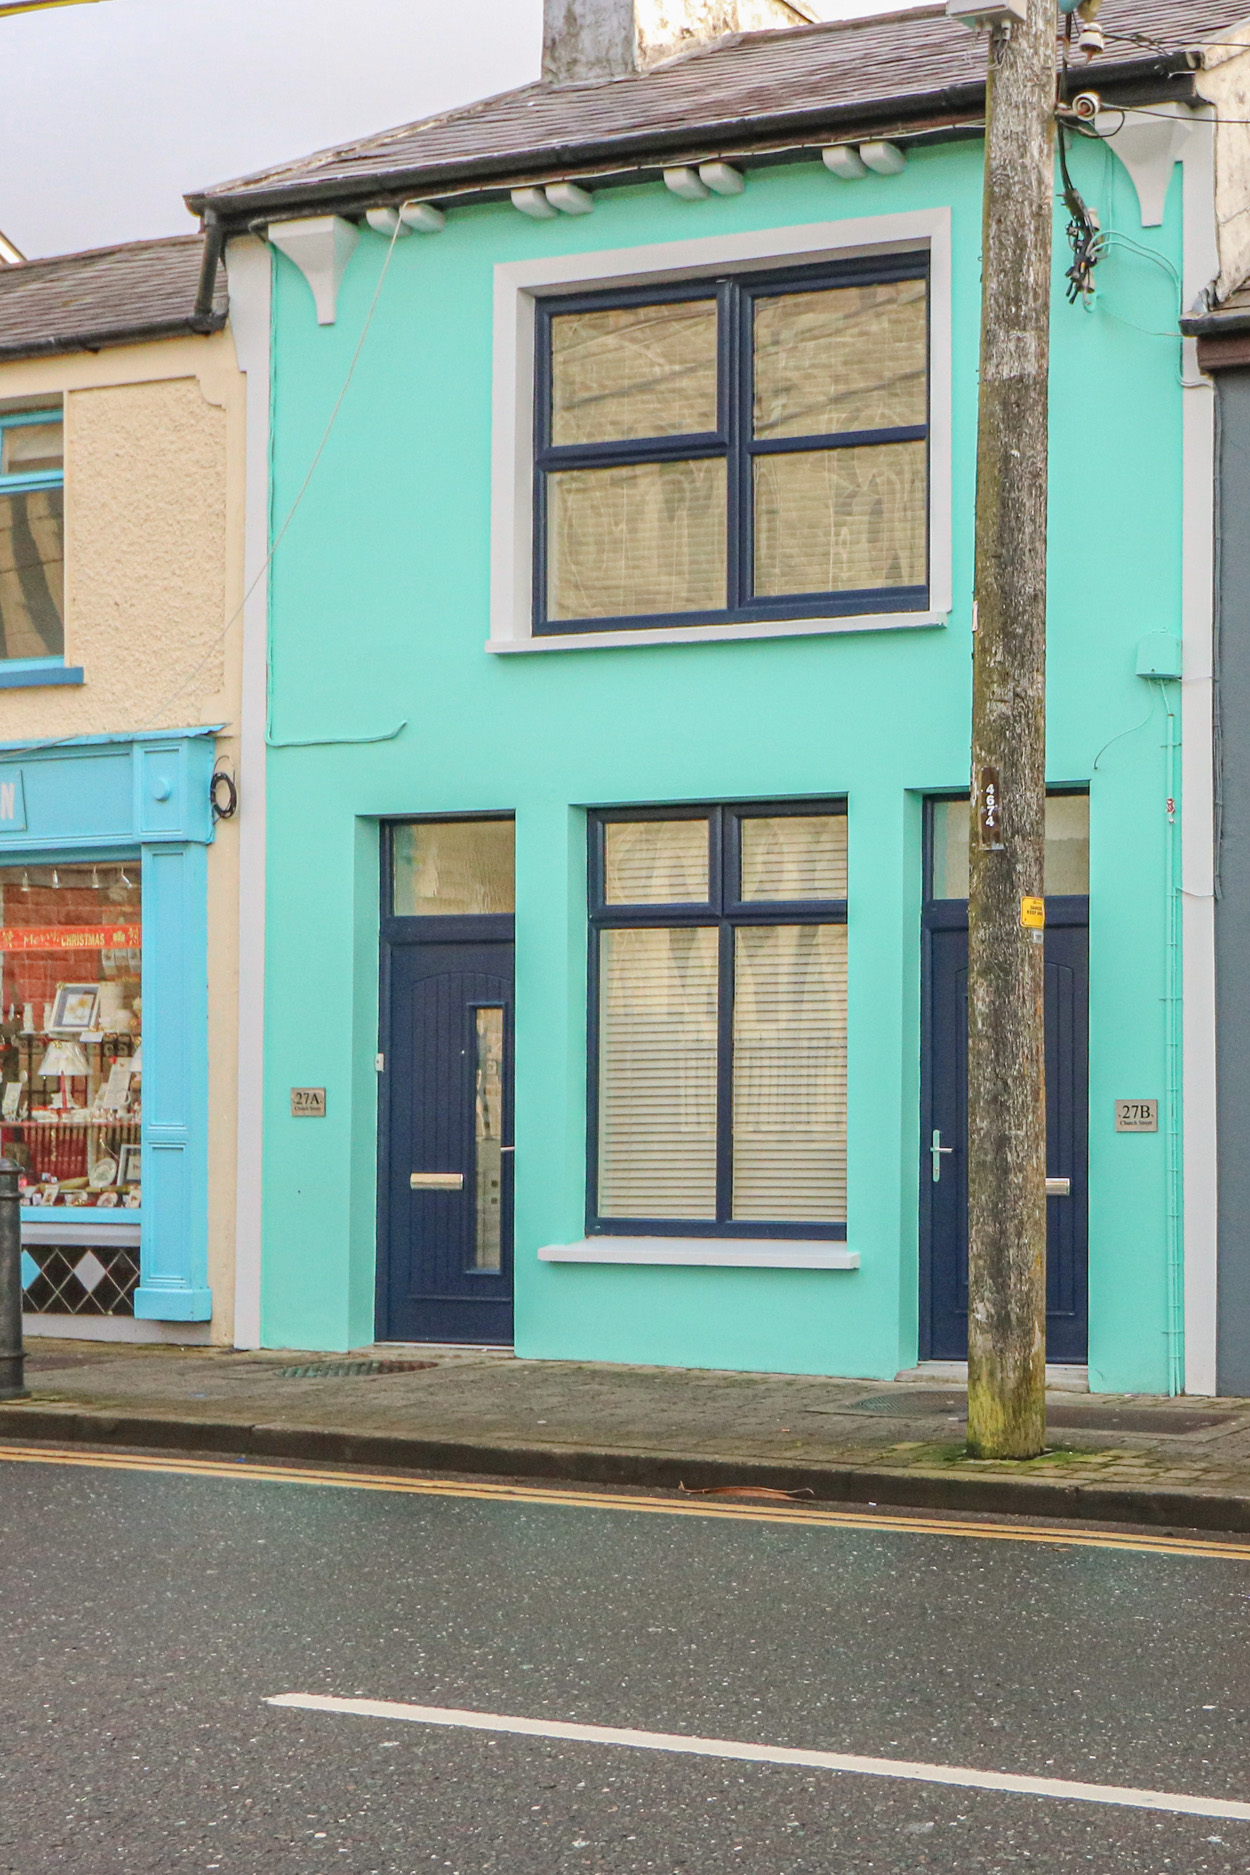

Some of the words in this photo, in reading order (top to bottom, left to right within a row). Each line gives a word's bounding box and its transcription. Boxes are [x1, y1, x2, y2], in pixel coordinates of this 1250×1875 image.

[985, 783, 995, 828] 4674
[61, 933, 105, 947] CHRISTMAS
[296, 1092, 320, 1105] 27A
[1122, 1104, 1151, 1119] 27B
